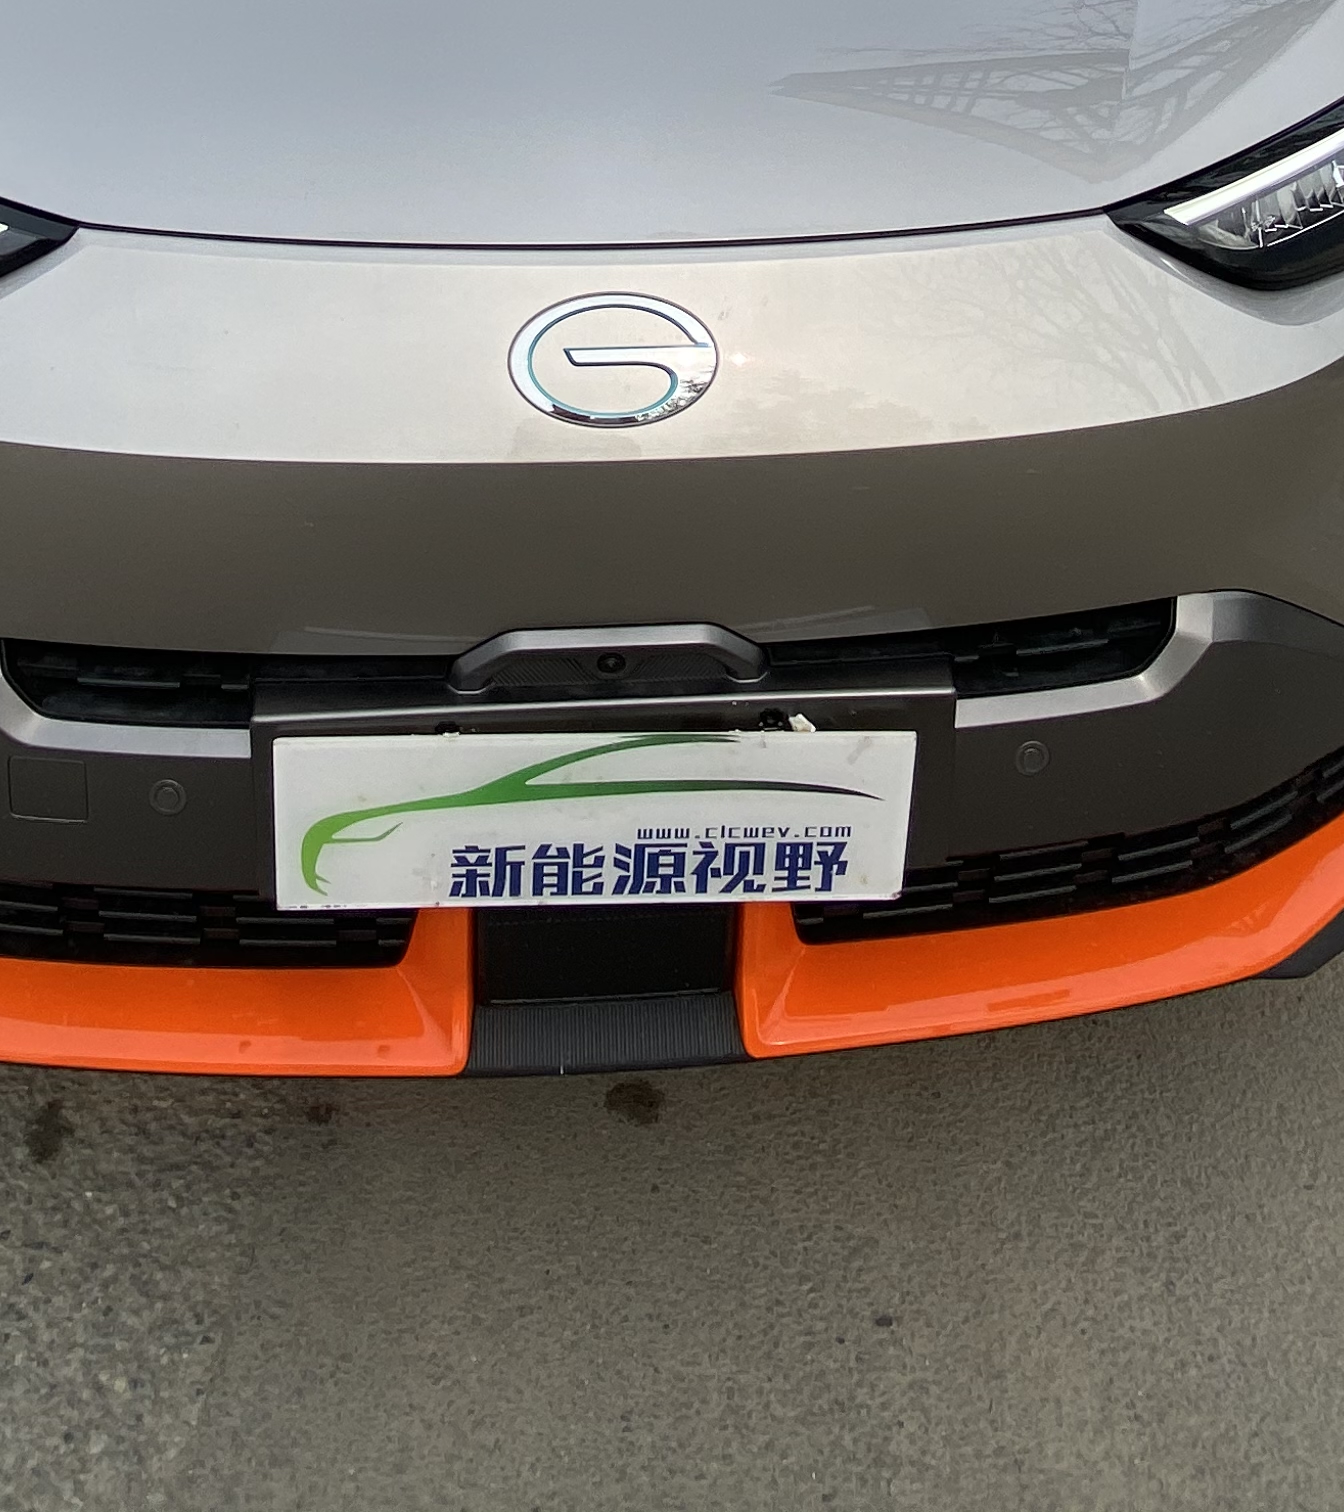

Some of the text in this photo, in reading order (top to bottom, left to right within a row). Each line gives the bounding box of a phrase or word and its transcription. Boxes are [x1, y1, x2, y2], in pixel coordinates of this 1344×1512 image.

[637, 824, 852, 840] www.clcwev.com
[449, 840, 849, 898] 新能源视野
